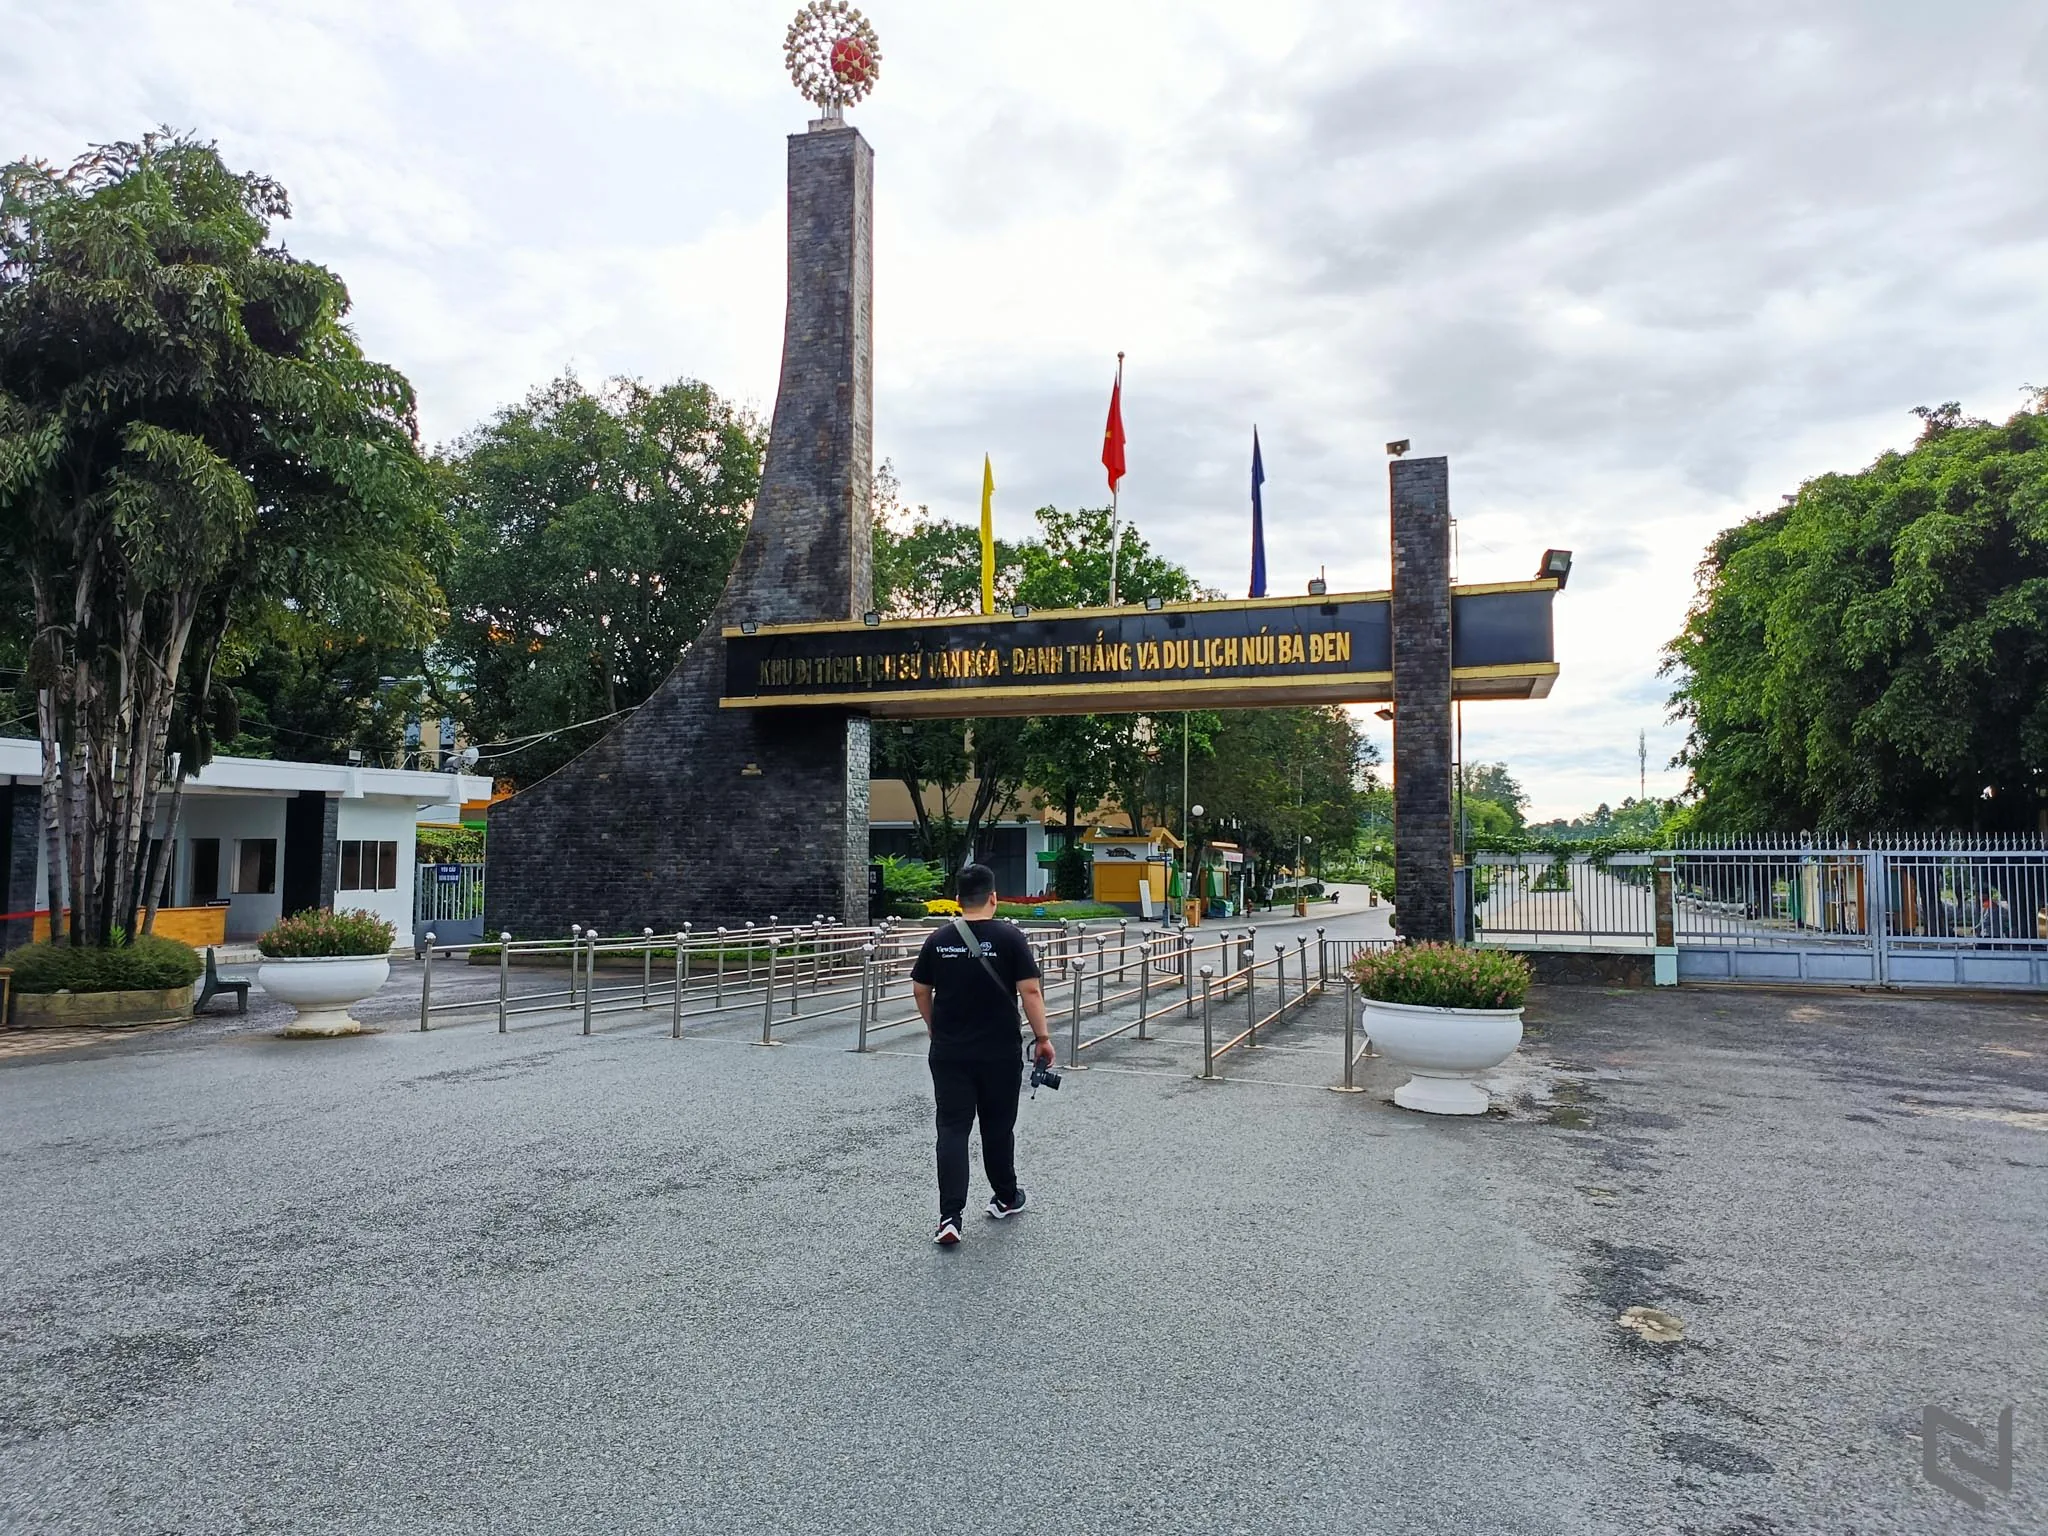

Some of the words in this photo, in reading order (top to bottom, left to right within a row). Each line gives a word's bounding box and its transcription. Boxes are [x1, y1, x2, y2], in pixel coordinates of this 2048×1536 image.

[760, 657, 793, 685] KHU
[815, 650, 853, 683] TÍCH
[856, 654, 896, 688] LỊCH
[899, 640, 923, 680] SỬ
[927, 644, 961, 680] VĂN
[962, 641, 1000, 677] HÓA
[1012, 646, 1063, 675] DANH
[1066, 630, 1132, 672] THẮNG
[1136, 634, 1160, 671] VÀ
[1163, 640, 1189, 669] DU
[1192, 637, 1237, 674] LỊCH
[1241, 626, 1275, 666] NÚI
[1309, 631, 1350, 663] ĐEN
